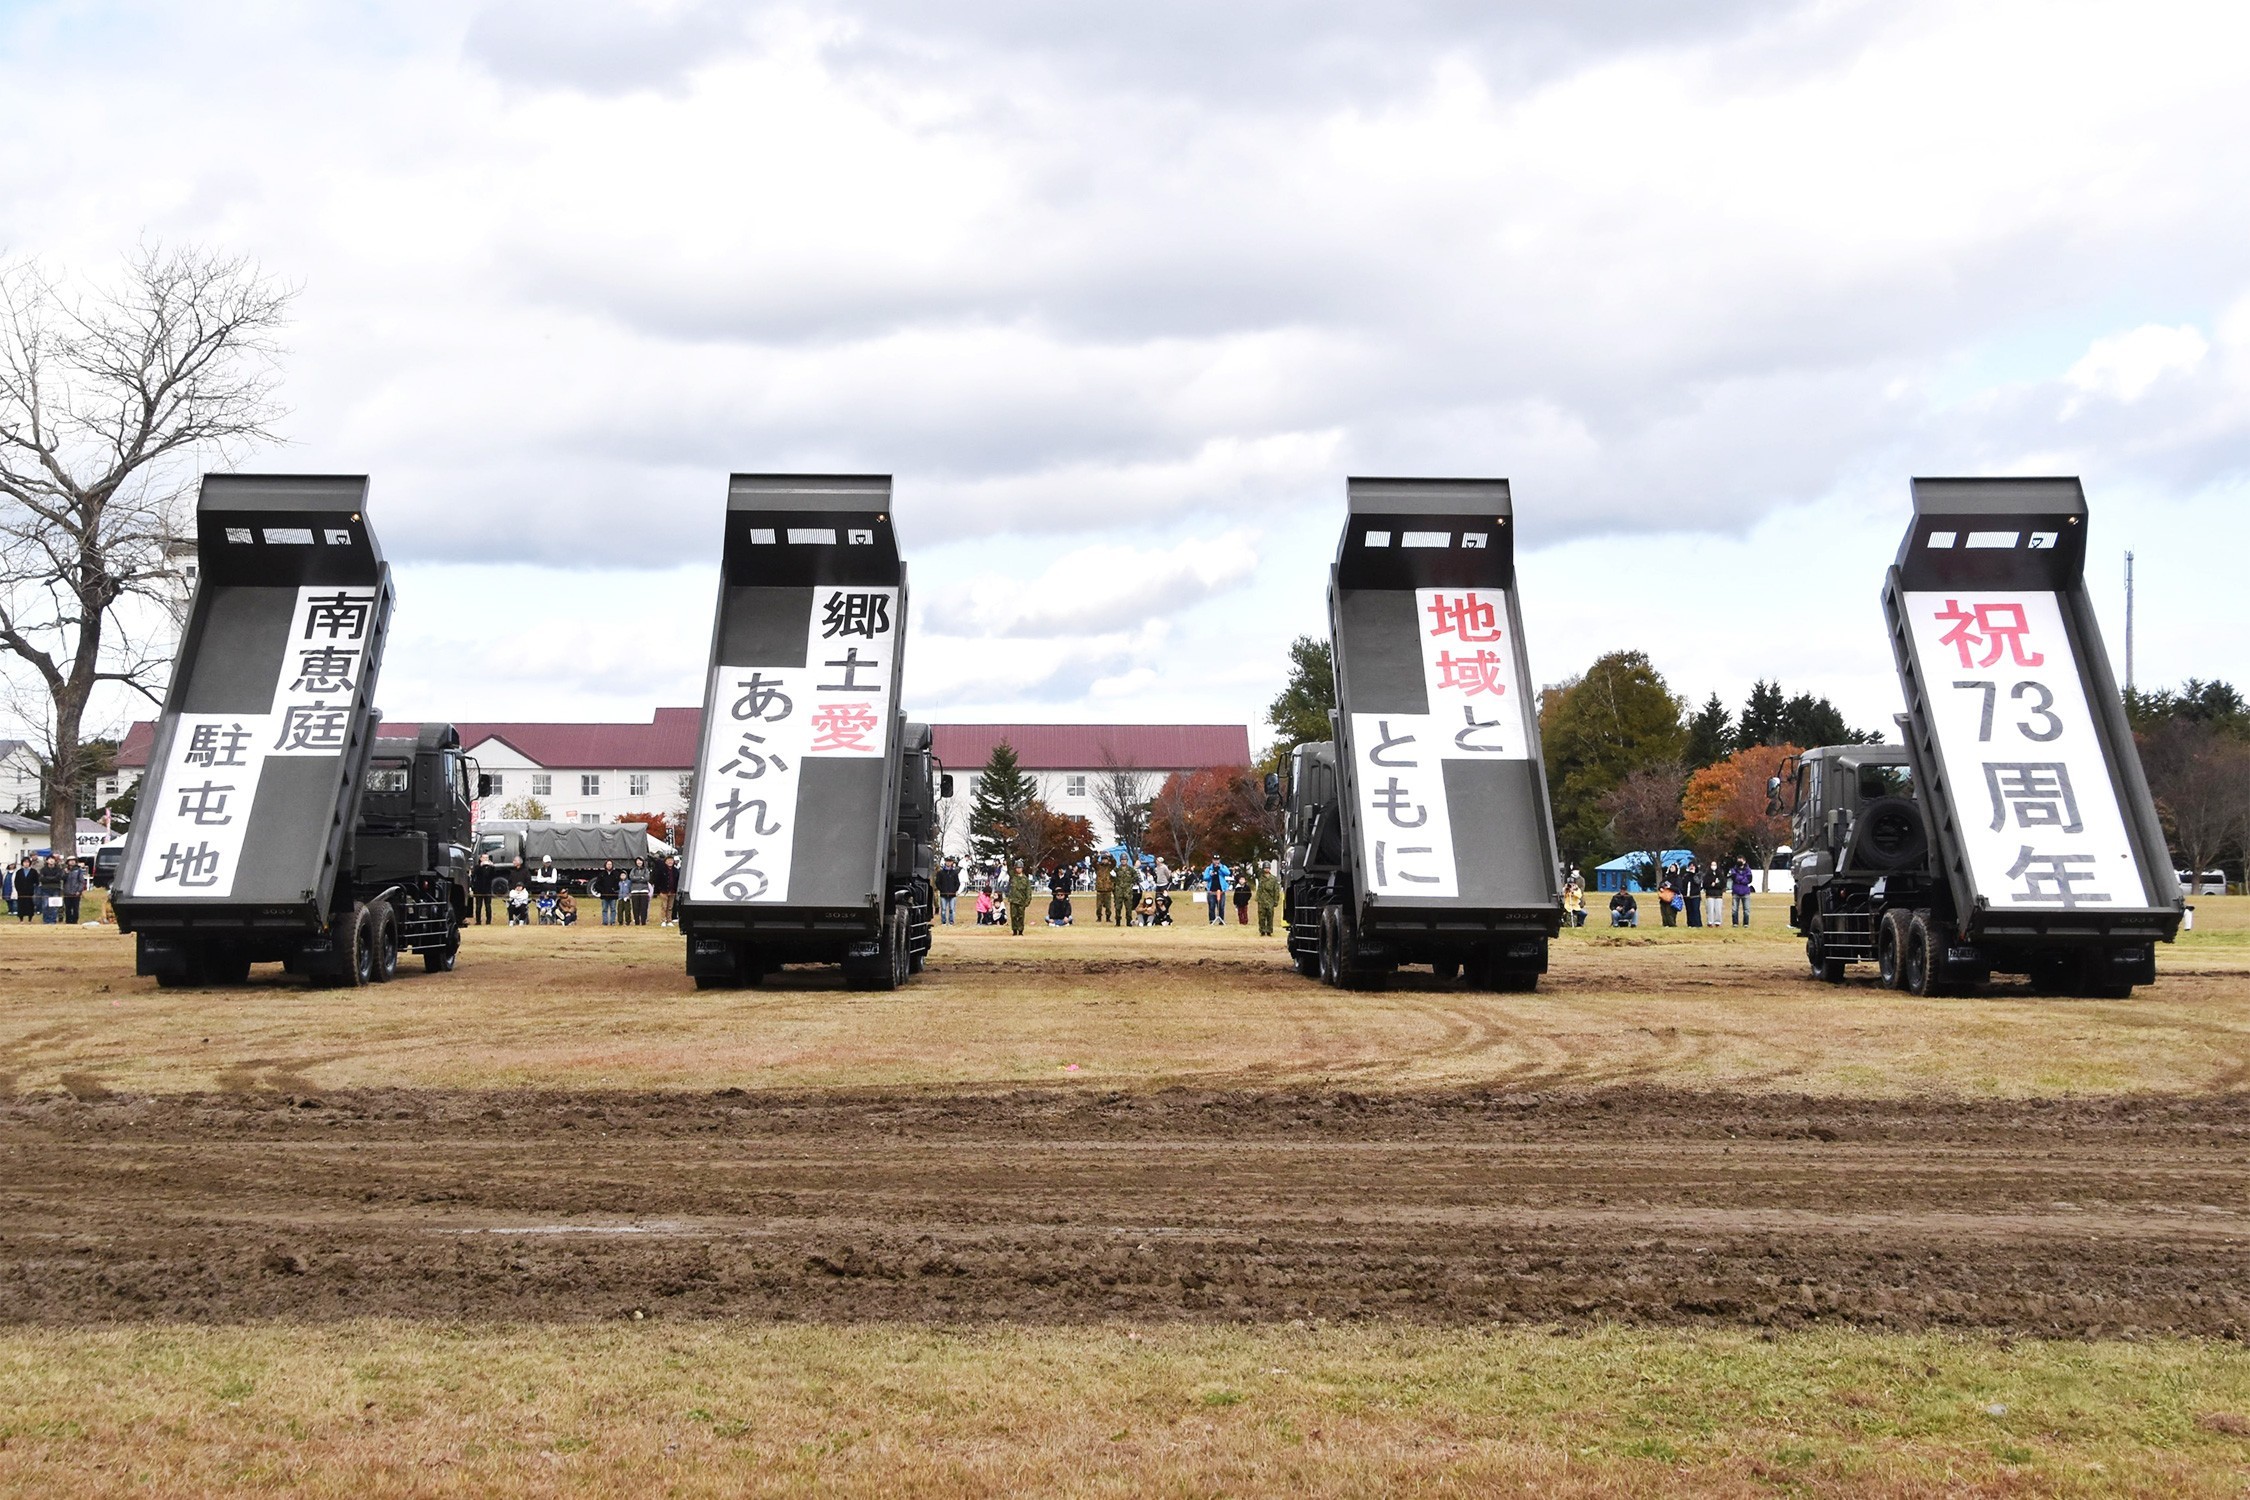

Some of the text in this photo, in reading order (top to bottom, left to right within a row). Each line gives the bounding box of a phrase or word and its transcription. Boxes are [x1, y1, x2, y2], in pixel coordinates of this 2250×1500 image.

[274, 592, 376, 752] 南恵庭
[810, 591, 891, 752] 郷土愛
[1427, 592, 1506, 753] 地域と
[1934, 599, 2112, 908] 祝73周年
[154, 723, 253, 887] 駐屯地
[709, 672, 793, 901] あふれる
[1369, 720, 1441, 887] ともに
